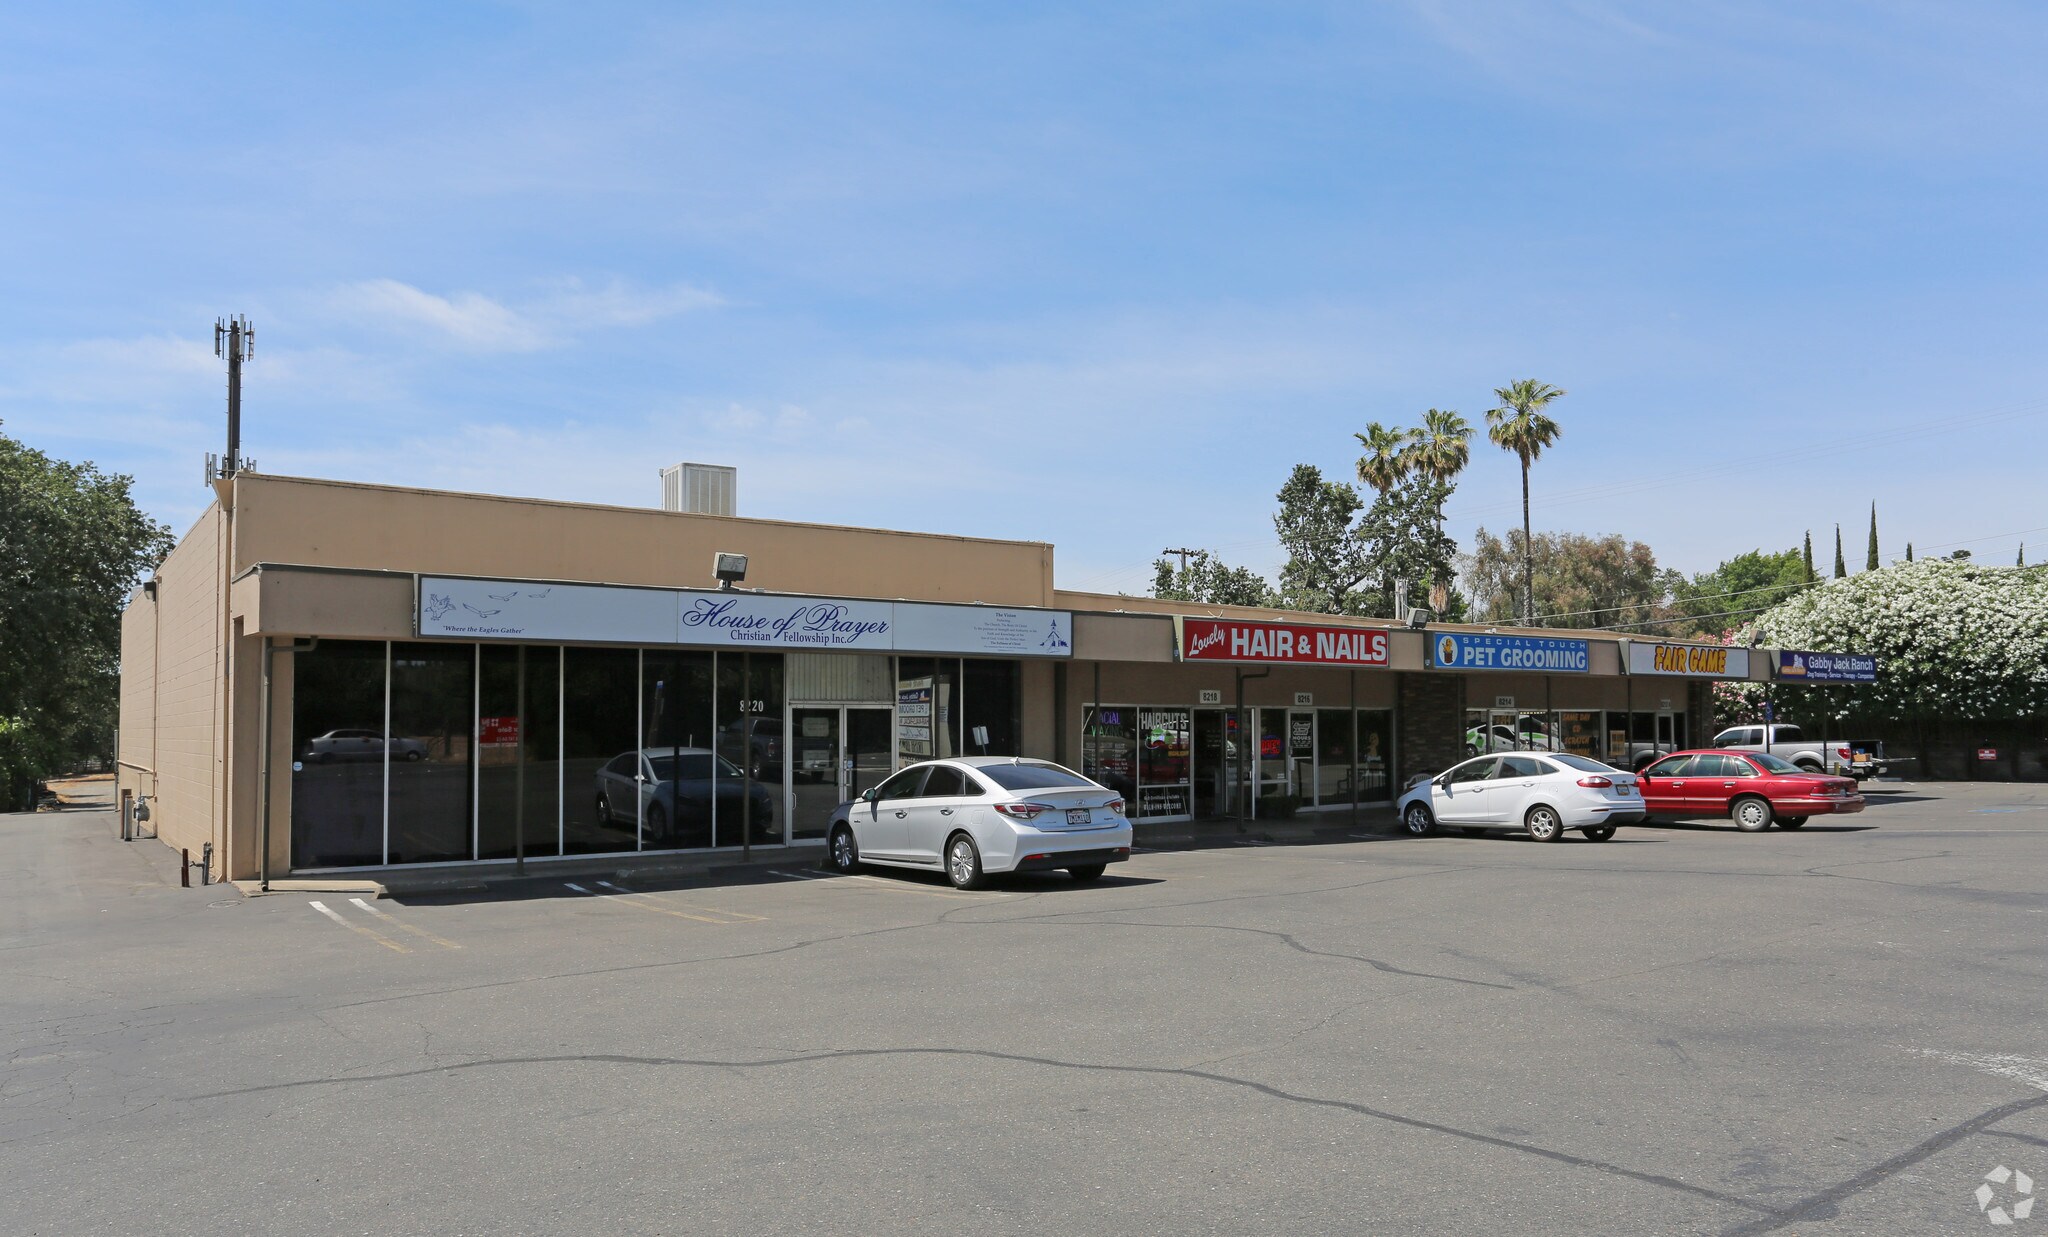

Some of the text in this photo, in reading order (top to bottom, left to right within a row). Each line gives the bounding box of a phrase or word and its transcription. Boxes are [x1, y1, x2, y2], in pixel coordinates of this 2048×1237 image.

[682, 598, 890, 643] House of Prayer
[479, 626, 499, 634] Eagles
[730, 630, 847, 646] Christian Fellowship Inc.
[1188, 624, 1387, 661] Lovely HAIR & NAILS
[1462, 637, 1586, 649] SPECIAL TOUCH
[1463, 646, 1586, 669] PET GROOMING
[1654, 646, 1727, 674] FAIR GAME
[1808, 656, 1831, 672] Gabby
[1834, 658, 1851, 670] Jack
[1851, 659, 1873, 671] Ranch
[1203, 692, 1218, 702] 8218
[1297, 694, 1311, 704] 8216
[1498, 697, 1512, 705] 8214
[1140, 712, 1187, 730] HAIRCUTS
